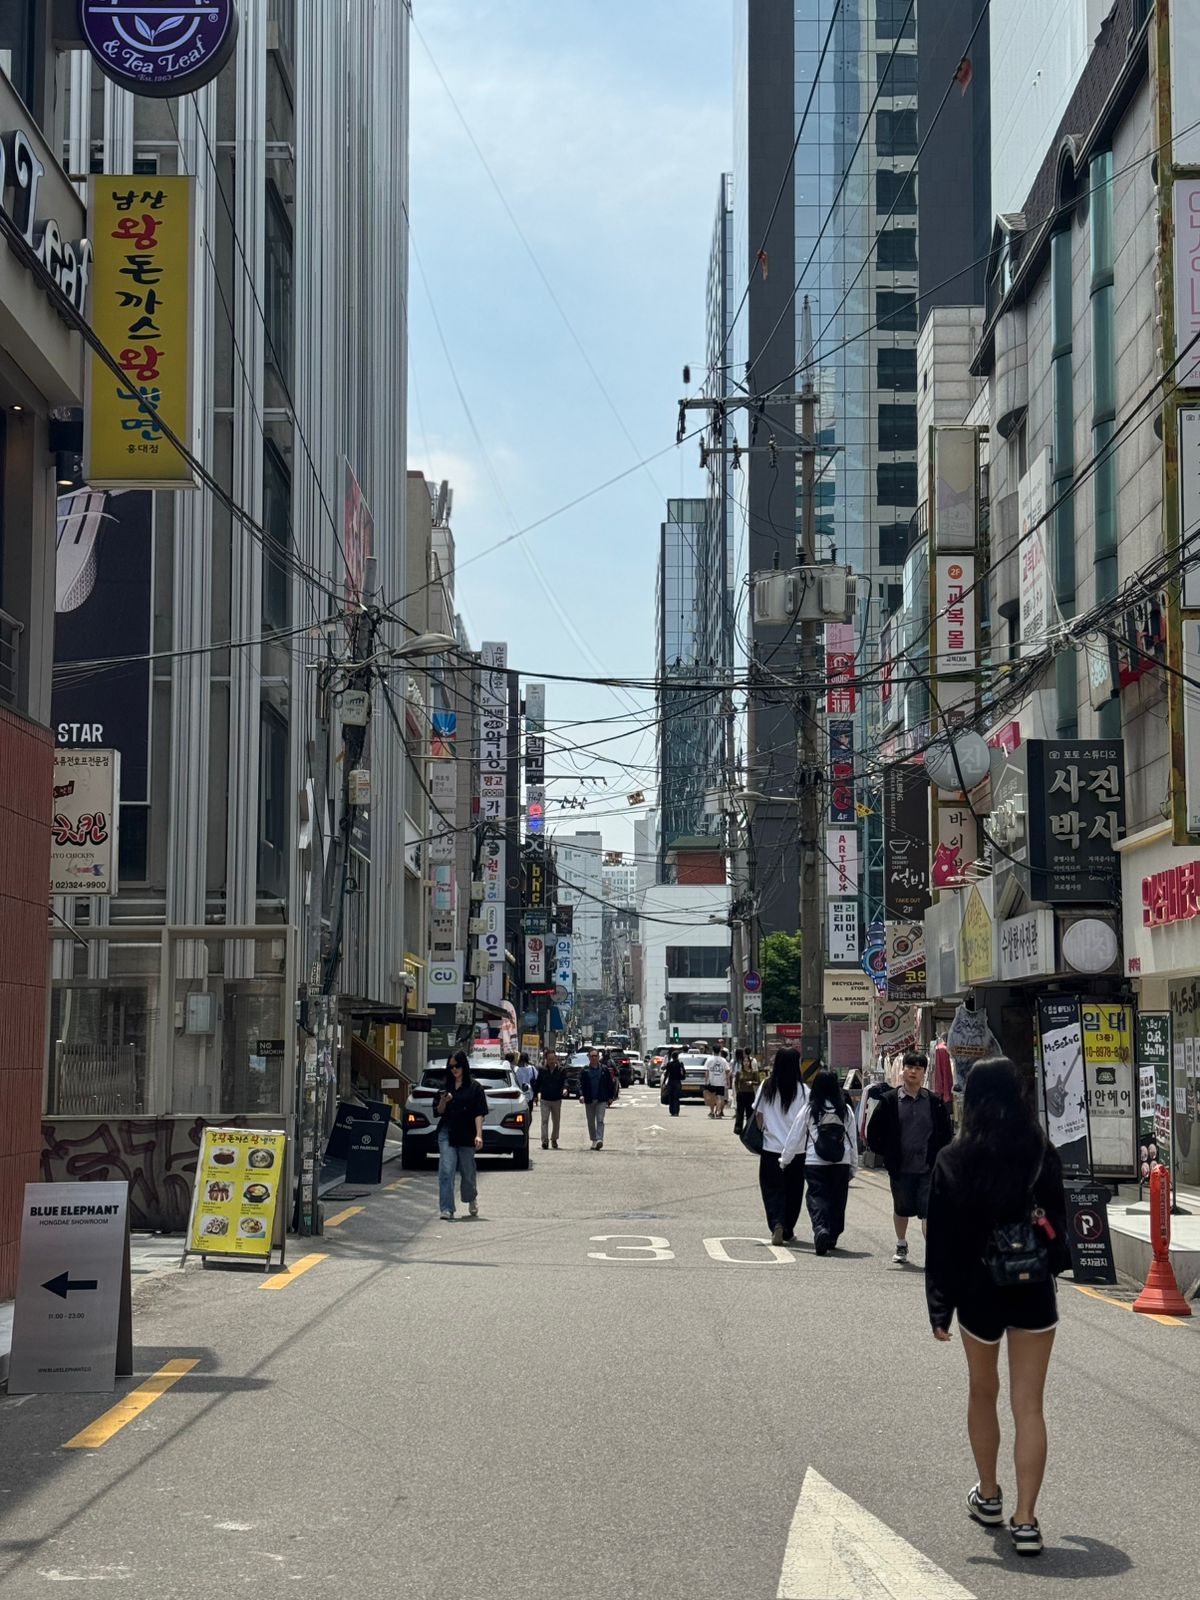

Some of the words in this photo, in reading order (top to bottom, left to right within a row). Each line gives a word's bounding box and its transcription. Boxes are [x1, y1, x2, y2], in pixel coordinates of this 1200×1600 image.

[103, 39, 120, 58] &
[121, 49, 154, 74] Tea
[158, 34, 207, 73] Leaf
[112, 190, 168, 210] 남산
[126, 444, 159, 455] 홍대점
[949, 568, 960, 576] 2F
[57, 722, 105, 743] STAR
[1063, 750, 1080, 759] 포토
[1083, 750, 1117, 759] 스튜디오
[483, 775, 503, 786] 망고
[1048, 764, 1121, 804] 사진
[837, 812, 848, 820] 4F
[1049, 810, 1126, 850] 박사
[838, 834, 848, 892] ARTBOX
[55, 881, 106, 889] 02)324-9900
[531, 863, 541, 903] bhc
[903, 905, 913, 914] 2F
[529, 951, 541, 977] 코인
[434, 970, 452, 981] CU
[1083, 1012, 1126, 1032] 임대
[30, 1205, 59, 1217] BLUE
[61, 1204, 119, 1216] ELEPHANT
[1080, 1257, 1107, 1267] 주차금지
